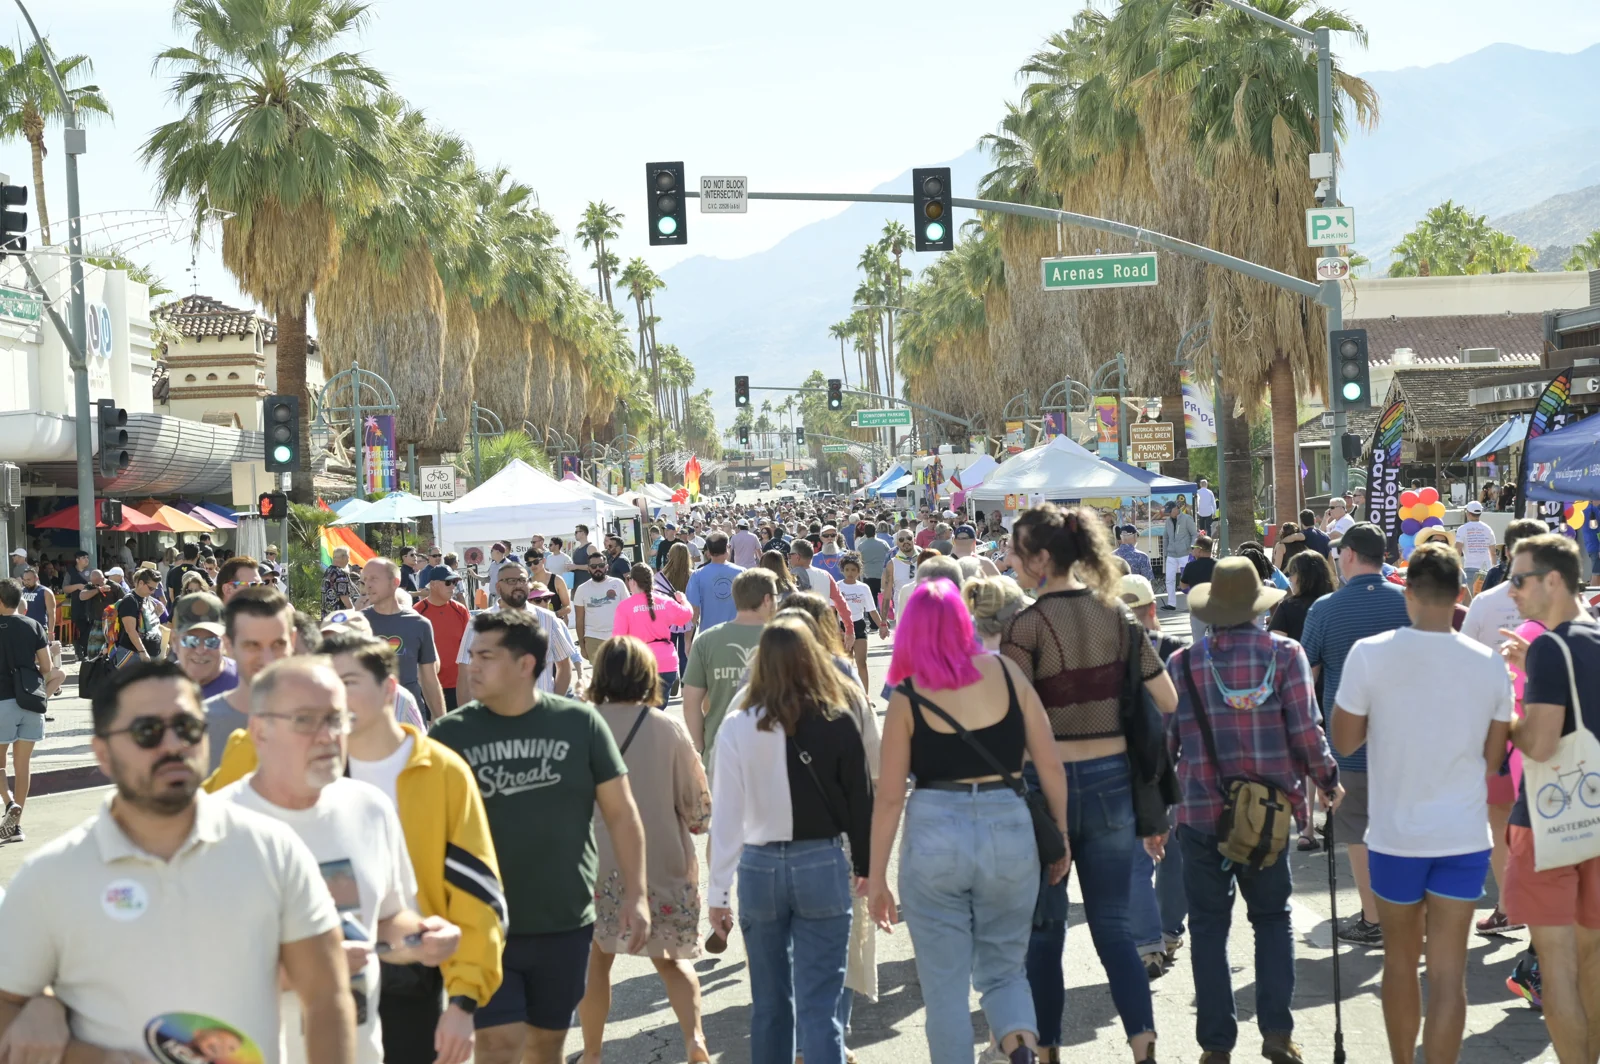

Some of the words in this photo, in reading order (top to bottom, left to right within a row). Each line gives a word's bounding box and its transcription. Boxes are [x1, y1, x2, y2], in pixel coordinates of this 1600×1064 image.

[703, 180, 711, 189] DO
[713, 180, 724, 189] NOT
[726, 180, 744, 189] BLOCK
[704, 190, 744, 199] INTERSECTION
[1052, 267, 1104, 282] Arenas
[1113, 263, 1149, 279] Road
[1325, 261, 1341, 276] 13
[1184, 401, 1214, 427] PRIDE
[367, 450, 394, 458] GREATER
[1143, 452, 1162, 460] BACK
[367, 468, 395, 476] PRIDE
[1370, 448, 1385, 524] pavilio
[463, 738, 570, 767] WINNING
[478, 757, 562, 798] Streak
